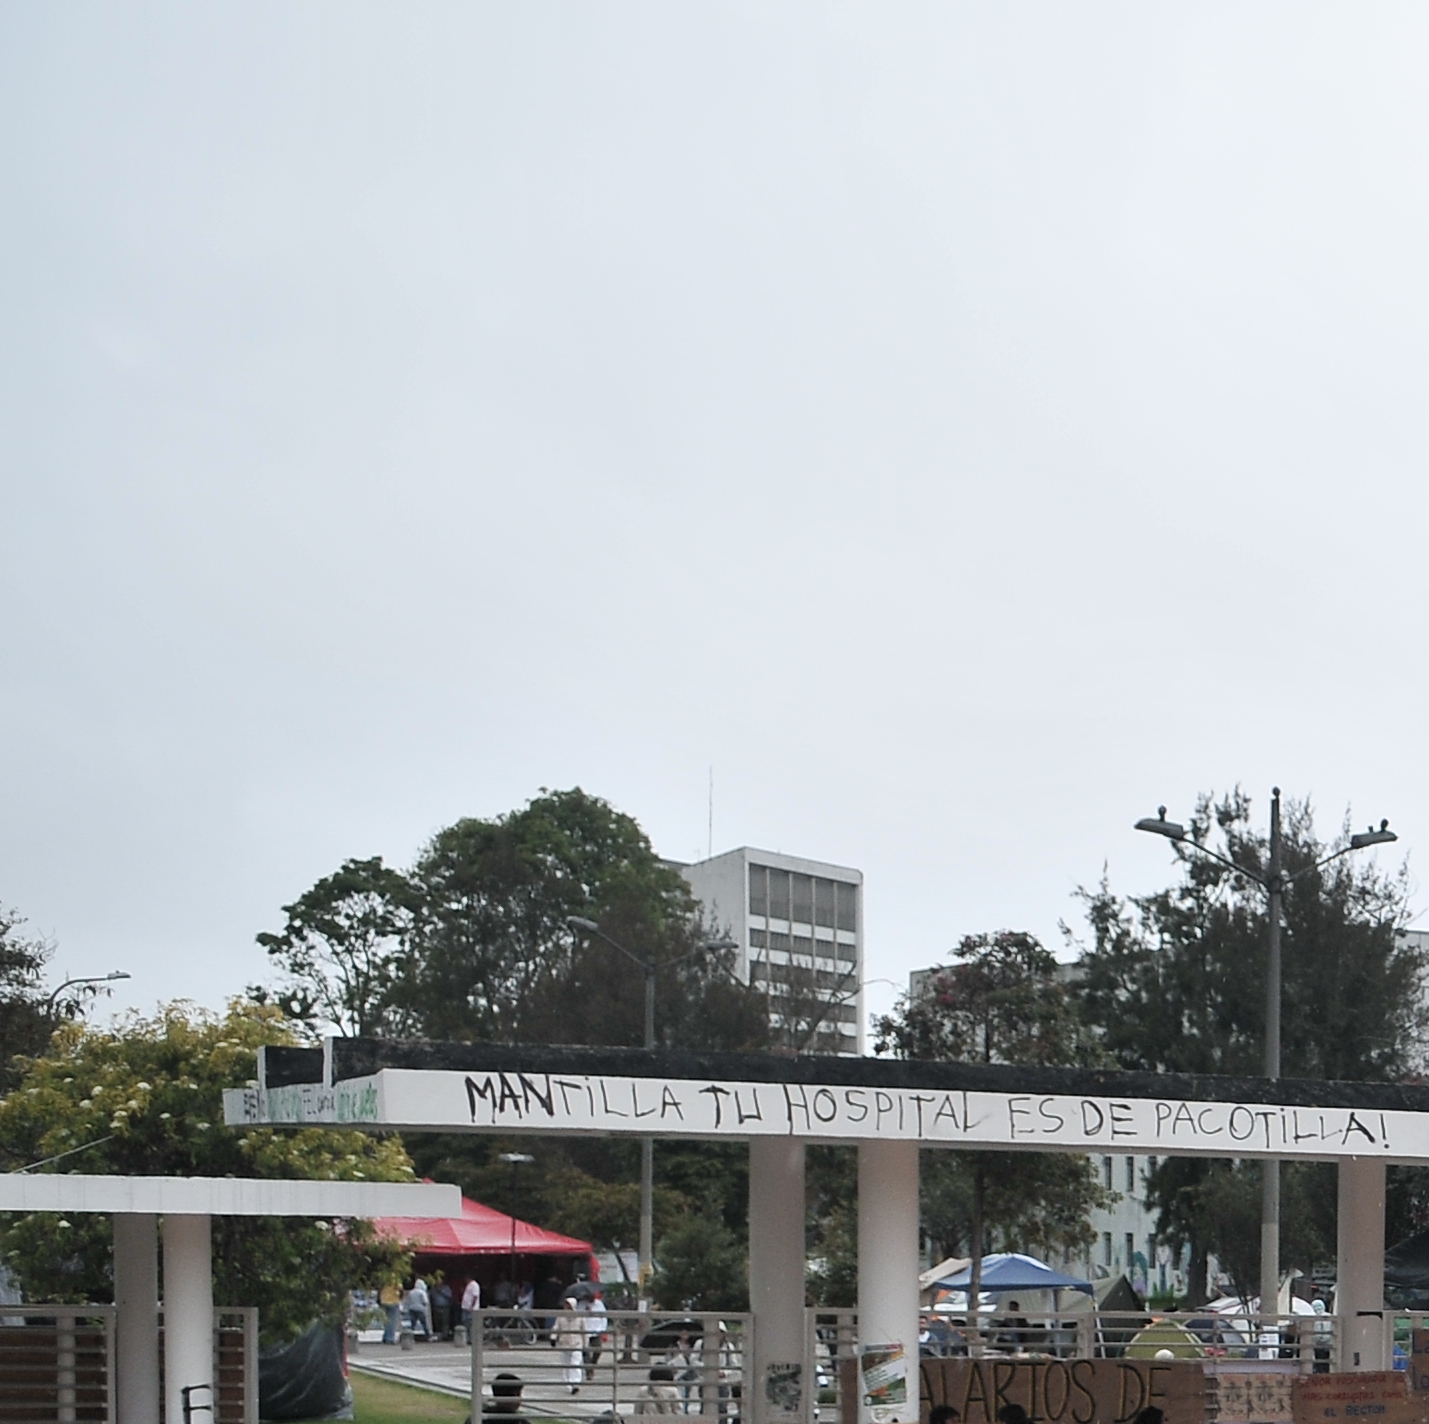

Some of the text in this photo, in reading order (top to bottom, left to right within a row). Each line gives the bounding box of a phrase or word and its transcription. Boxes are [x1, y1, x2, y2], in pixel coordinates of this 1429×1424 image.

[699, 1085, 762, 1128] TU
[783, 1083, 974, 1137] HOSPITAL
[1008, 1097, 1064, 1139] ES
[1080, 1099, 1137, 1140] DE
[920, 1360, 1172, 1424] ALARIOS DE
[1345, 1404, 1385, 1416] RECTOR
